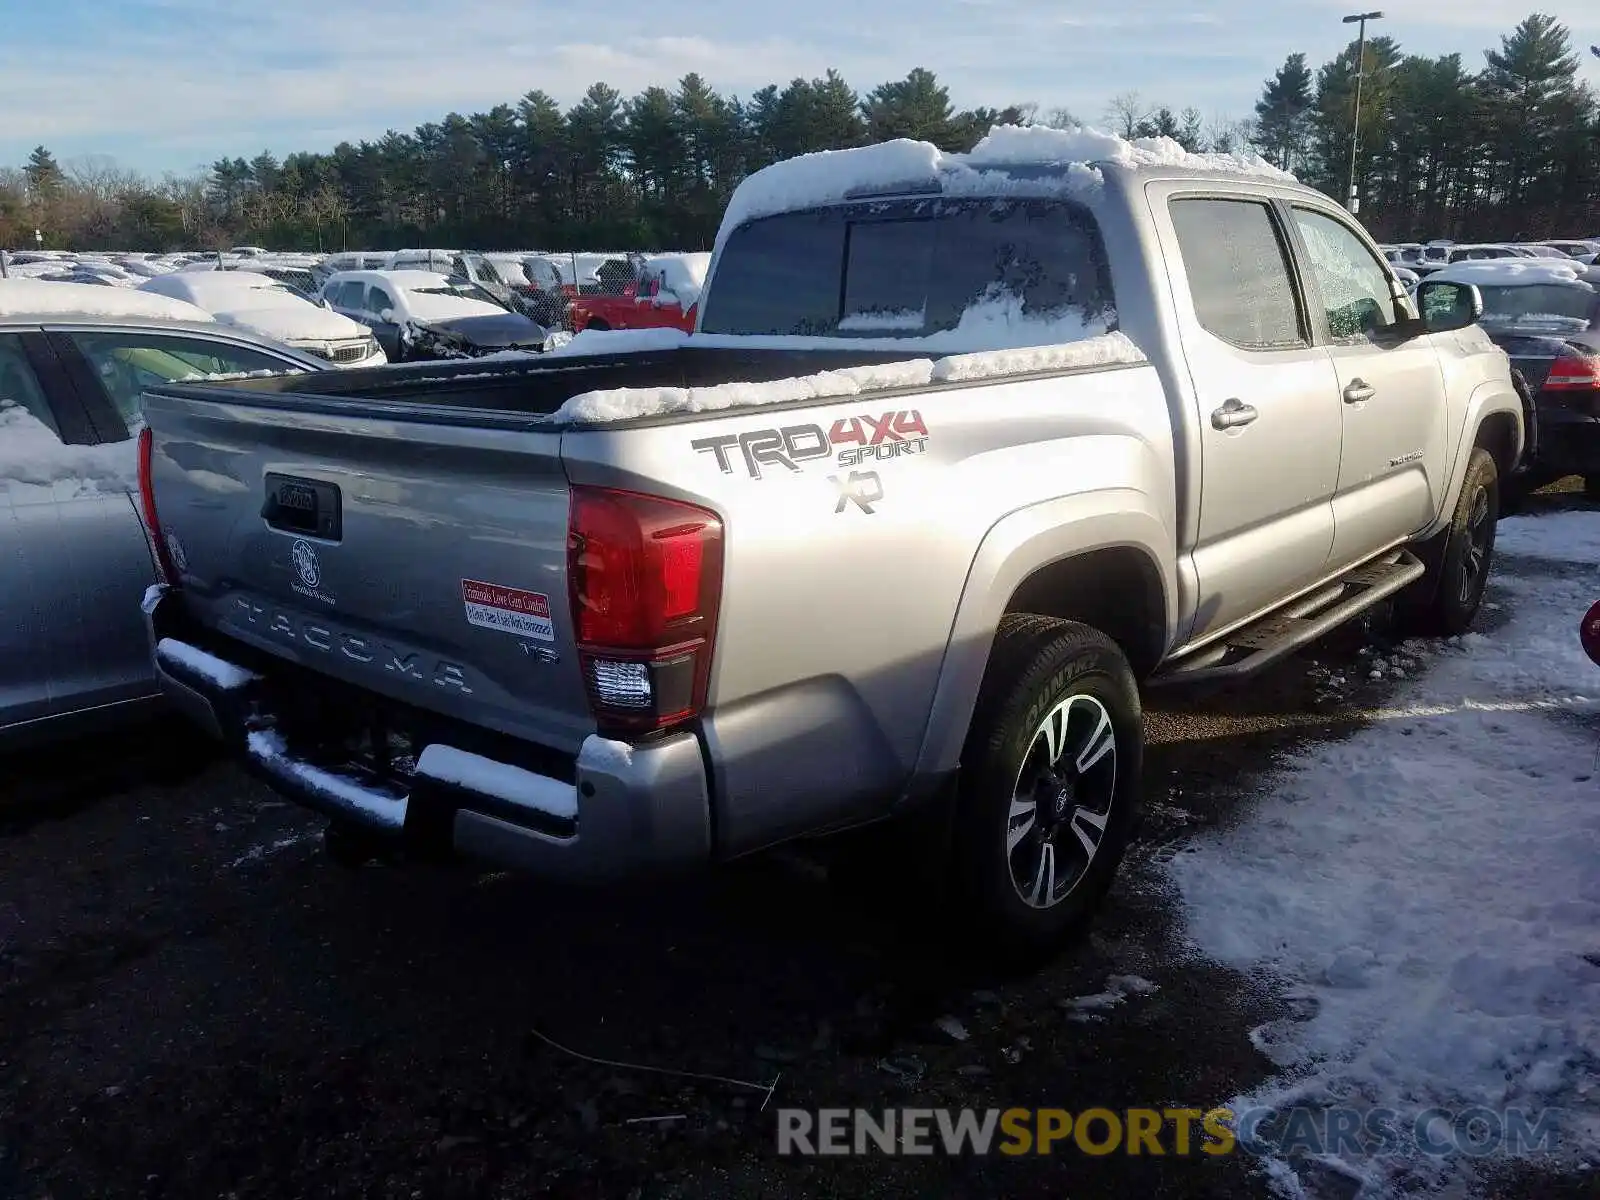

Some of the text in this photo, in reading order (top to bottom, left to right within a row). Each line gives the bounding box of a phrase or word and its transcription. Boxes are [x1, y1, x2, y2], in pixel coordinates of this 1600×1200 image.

[691, 423, 832, 481] TRD
[838, 436, 929, 468] SPORT
[233, 599, 474, 694] TACOMA
